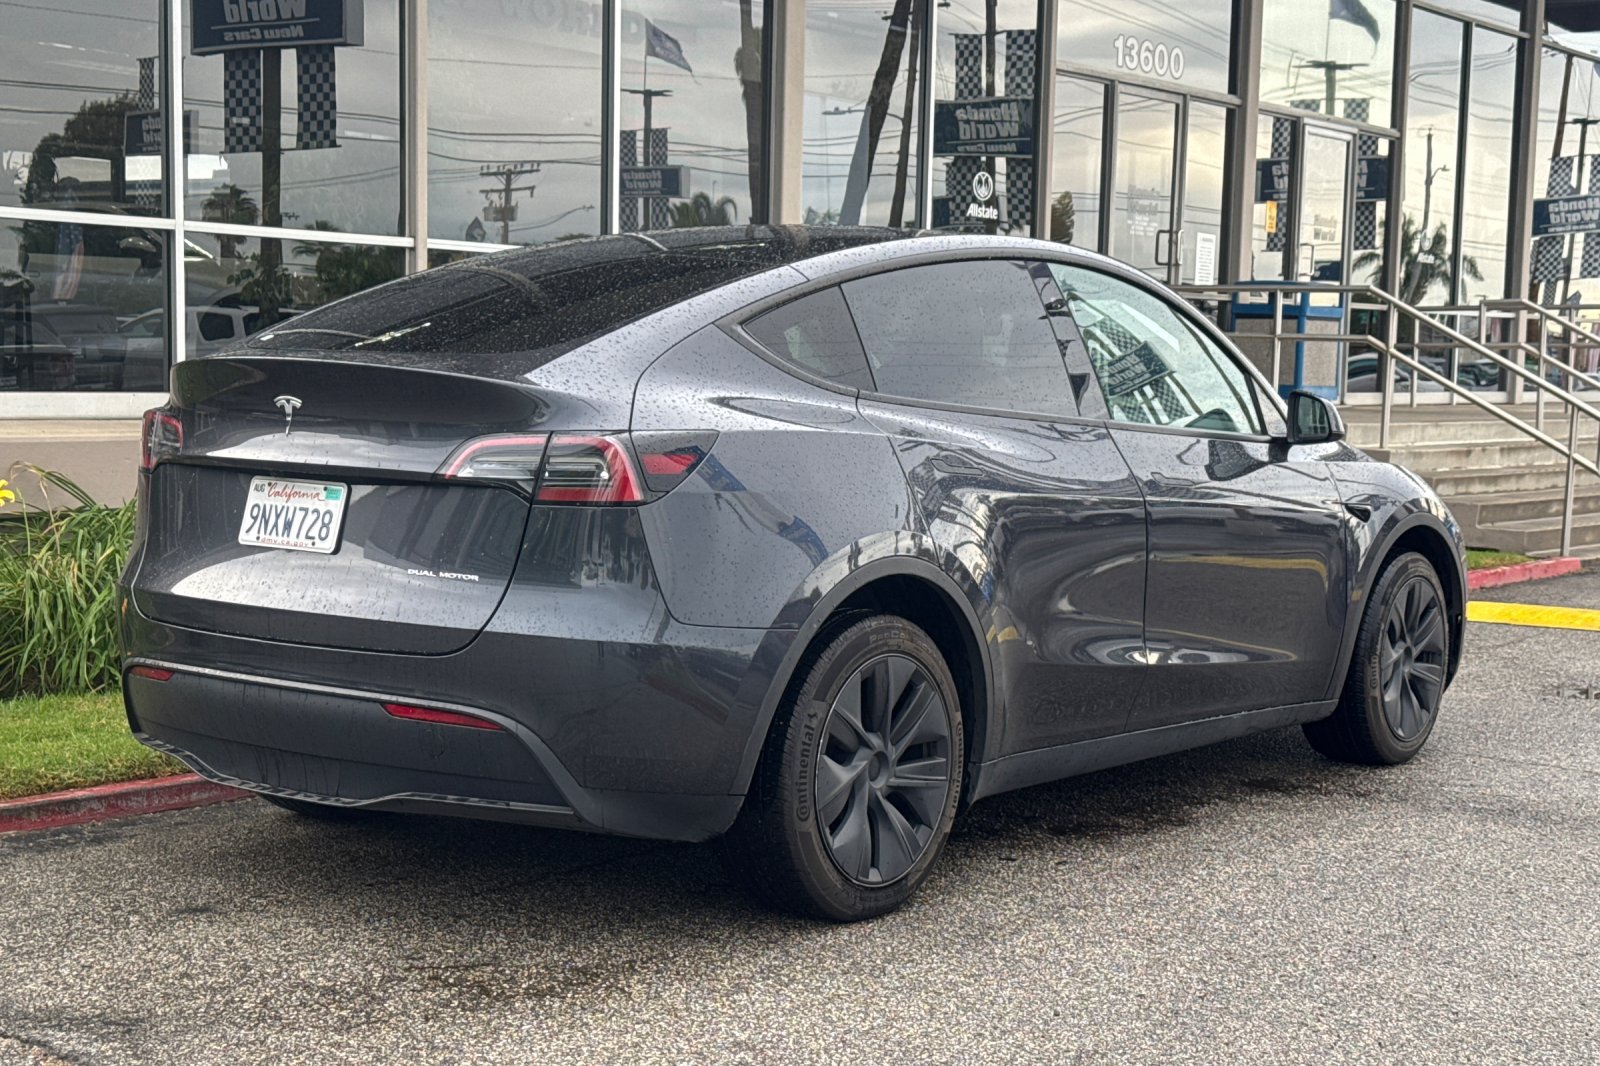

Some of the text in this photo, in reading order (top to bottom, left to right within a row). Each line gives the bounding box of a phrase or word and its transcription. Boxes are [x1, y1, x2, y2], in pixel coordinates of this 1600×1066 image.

[1113, 33, 1184, 79] 13600
[966, 203, 998, 220] Allstate
[253, 483, 266, 493] AUG
[267, 482, 325, 504] California
[245, 503, 334, 542] 9NXW728
[407, 569, 480, 582] DUAL MOTOR
[795, 723, 815, 822] Continental
